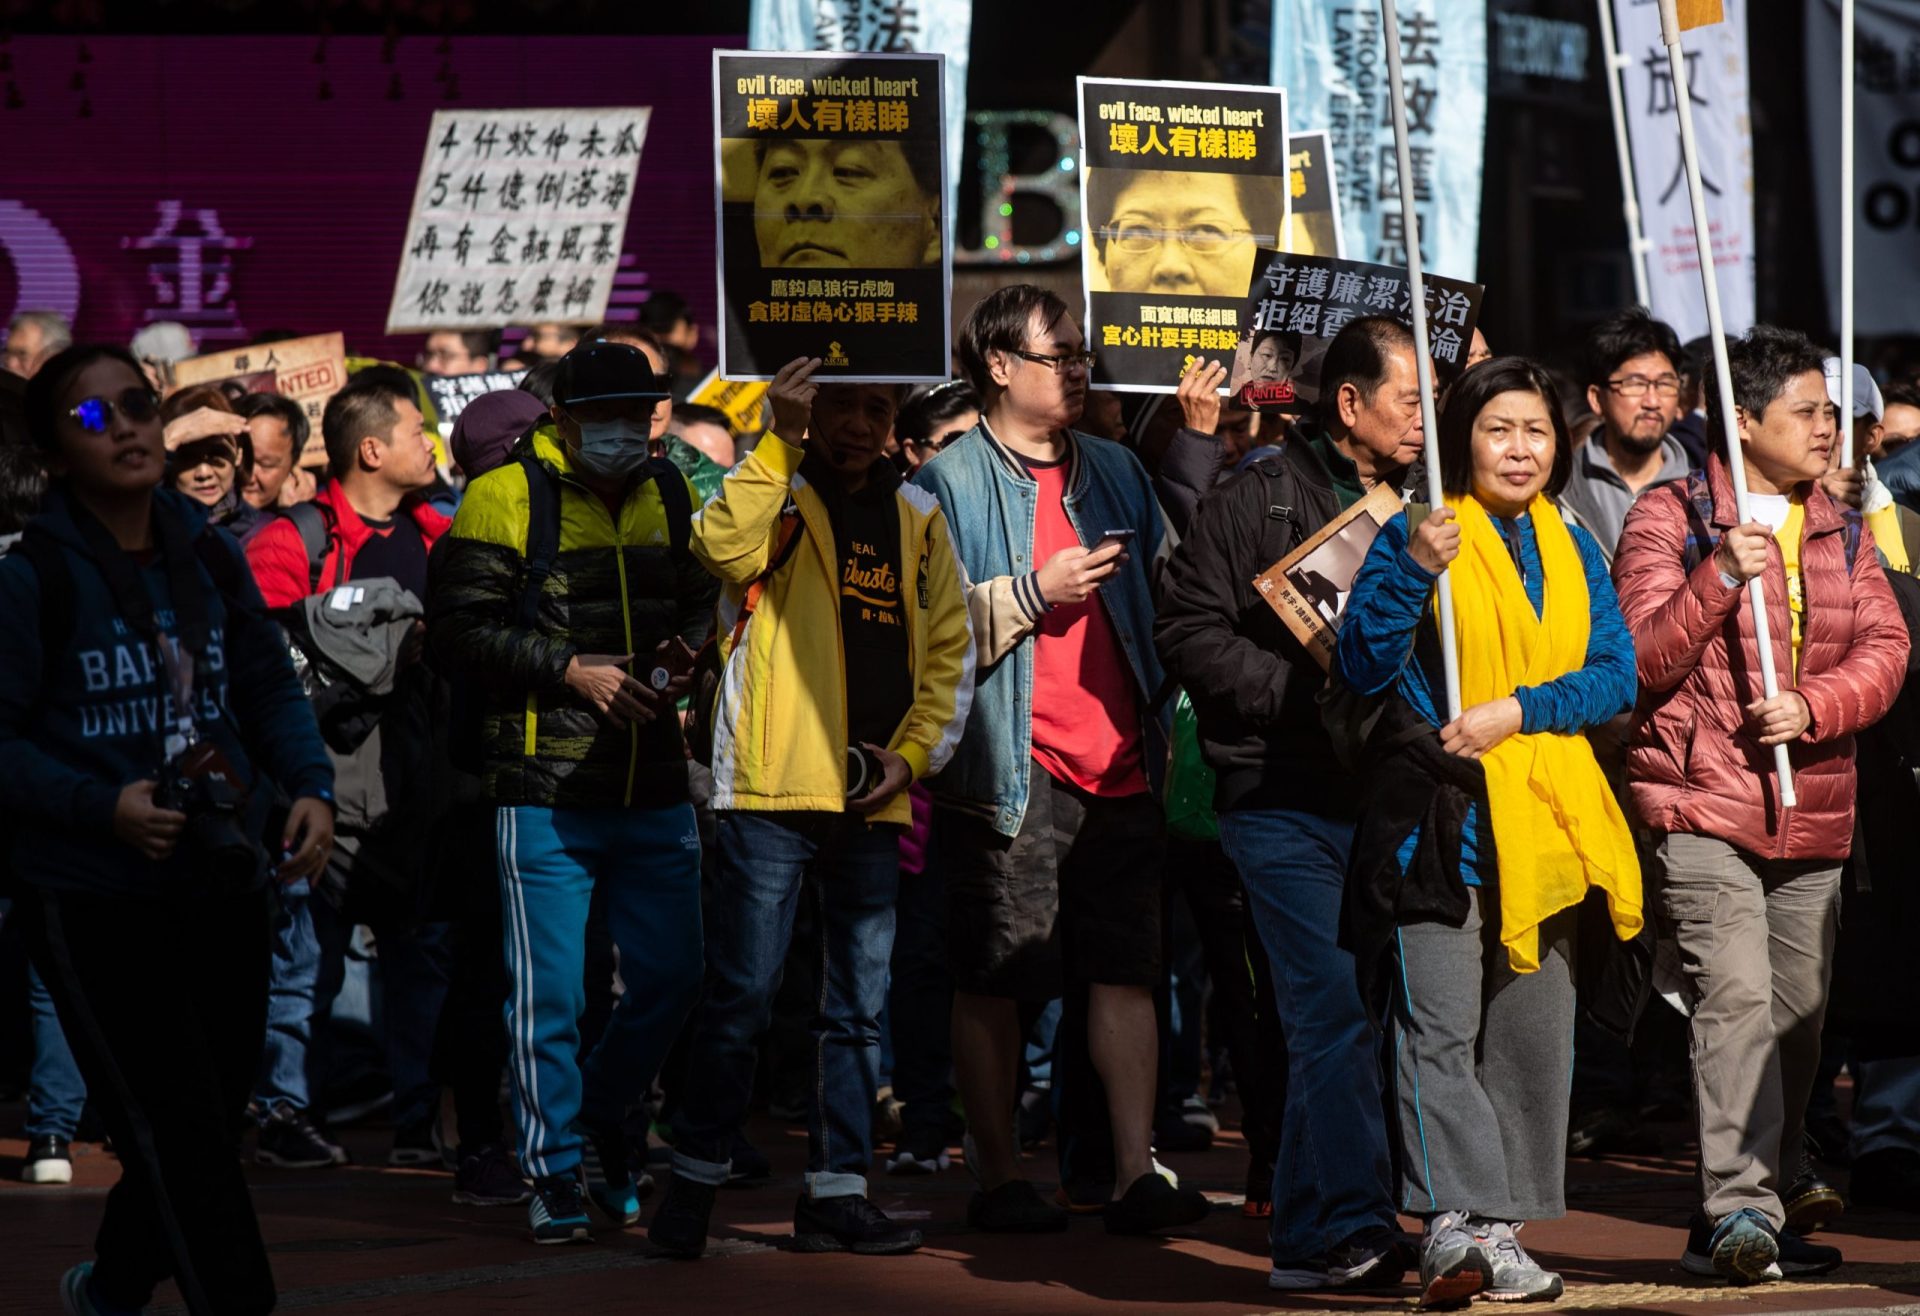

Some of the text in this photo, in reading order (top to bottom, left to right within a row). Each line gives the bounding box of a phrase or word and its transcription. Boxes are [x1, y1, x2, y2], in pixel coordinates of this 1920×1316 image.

[737, 75, 918, 97] evil face, wicked heart
[747, 98, 909, 132] 壞人有樣睇
[1099, 101, 1264, 127] evil face, wicked heart
[1350, 9, 1378, 213] PROGRESSIVE
[1109, 123, 1257, 160] 壞人有樣睇
[411, 222, 617, 267] 再有金融風暴
[1102, 324, 1241, 350] 宮心計耍手段缺
[1254, 299, 1464, 364] 拒絕香淪
[1243, 383, 1294, 401] WANTED
